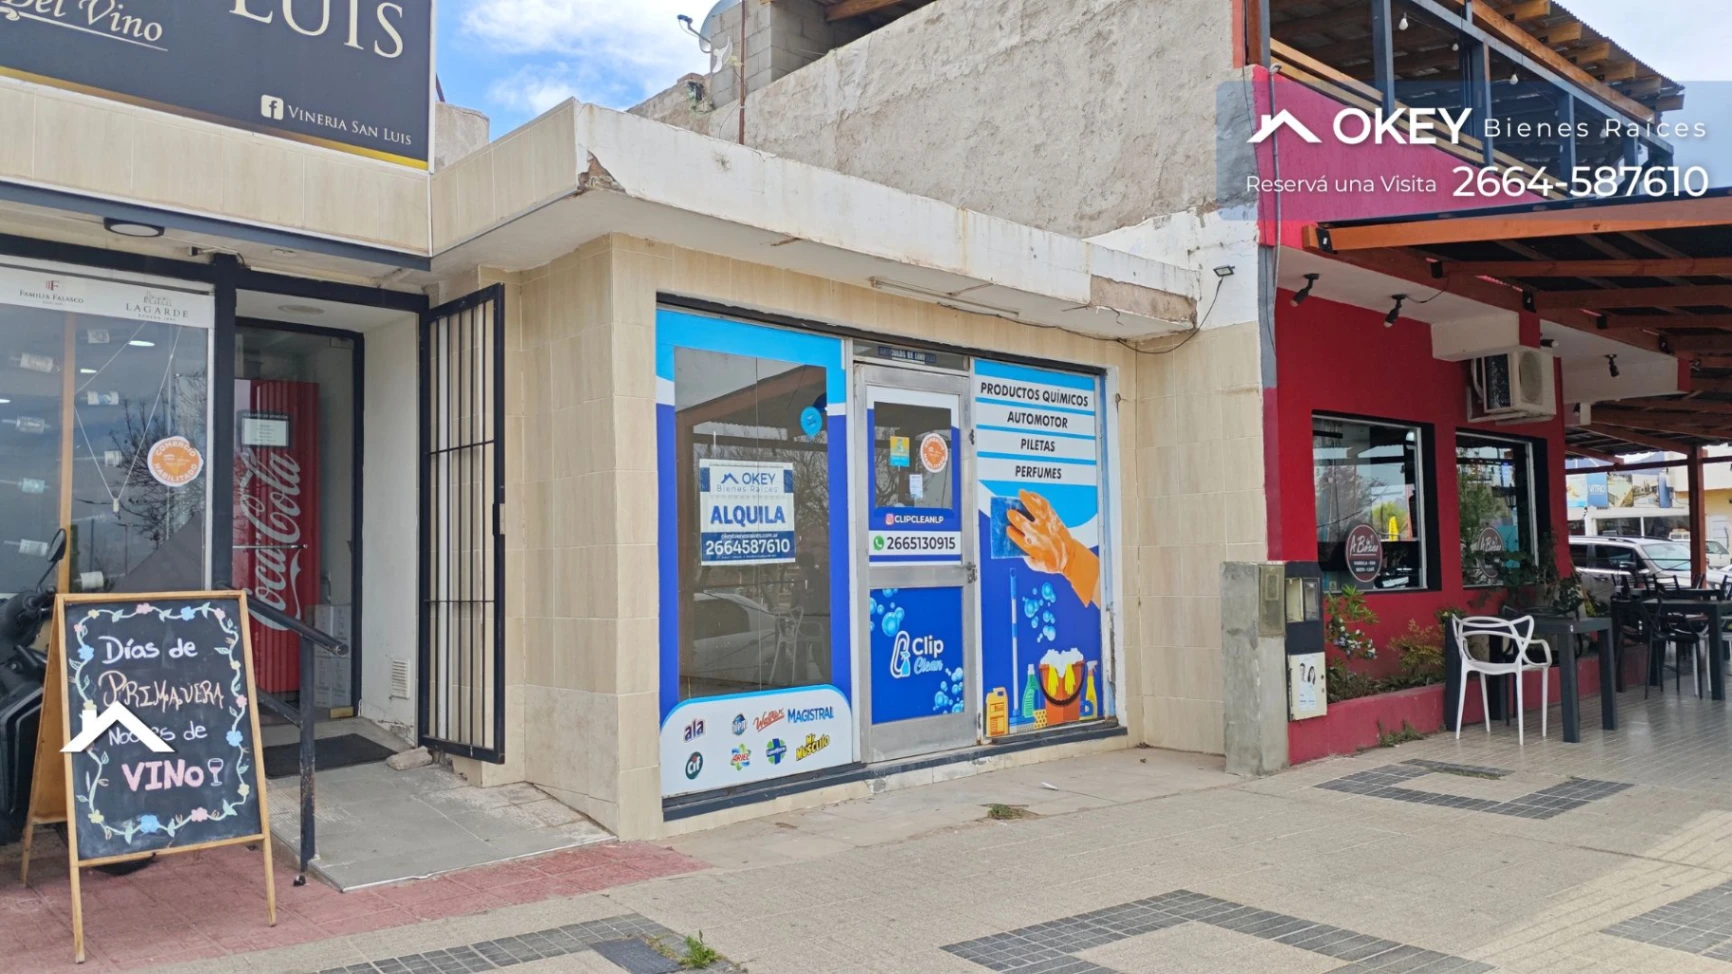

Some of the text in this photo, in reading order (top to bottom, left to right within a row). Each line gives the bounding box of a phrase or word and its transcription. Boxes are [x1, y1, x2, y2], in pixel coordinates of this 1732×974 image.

[2, 0, 162, 41] el Vino
[126, 303, 189, 318] LAGARDE
[980, 382, 1088, 407] PRODUCTOS QUÍMICOS
[1007, 411, 1068, 428] AUTOMOTOR
[1020, 439, 1055, 452] PILETAS
[742, 472, 776, 485] OKEY
[1015, 465, 1062, 479] PERFUMES
[717, 485, 746, 493] Bienes
[710, 505, 785, 527] ALQUILA
[894, 515, 944, 524] CLIPCLEANLP
[705, 538, 790, 556] 2664587610
[887, 536, 956, 550] 2665130915
[98, 636, 198, 664] Días de
[912, 635, 944, 658] Clip
[788, 706, 834, 723] MAGISTRAL
[183, 720, 208, 740] de
[684, 719, 704, 741] ala
